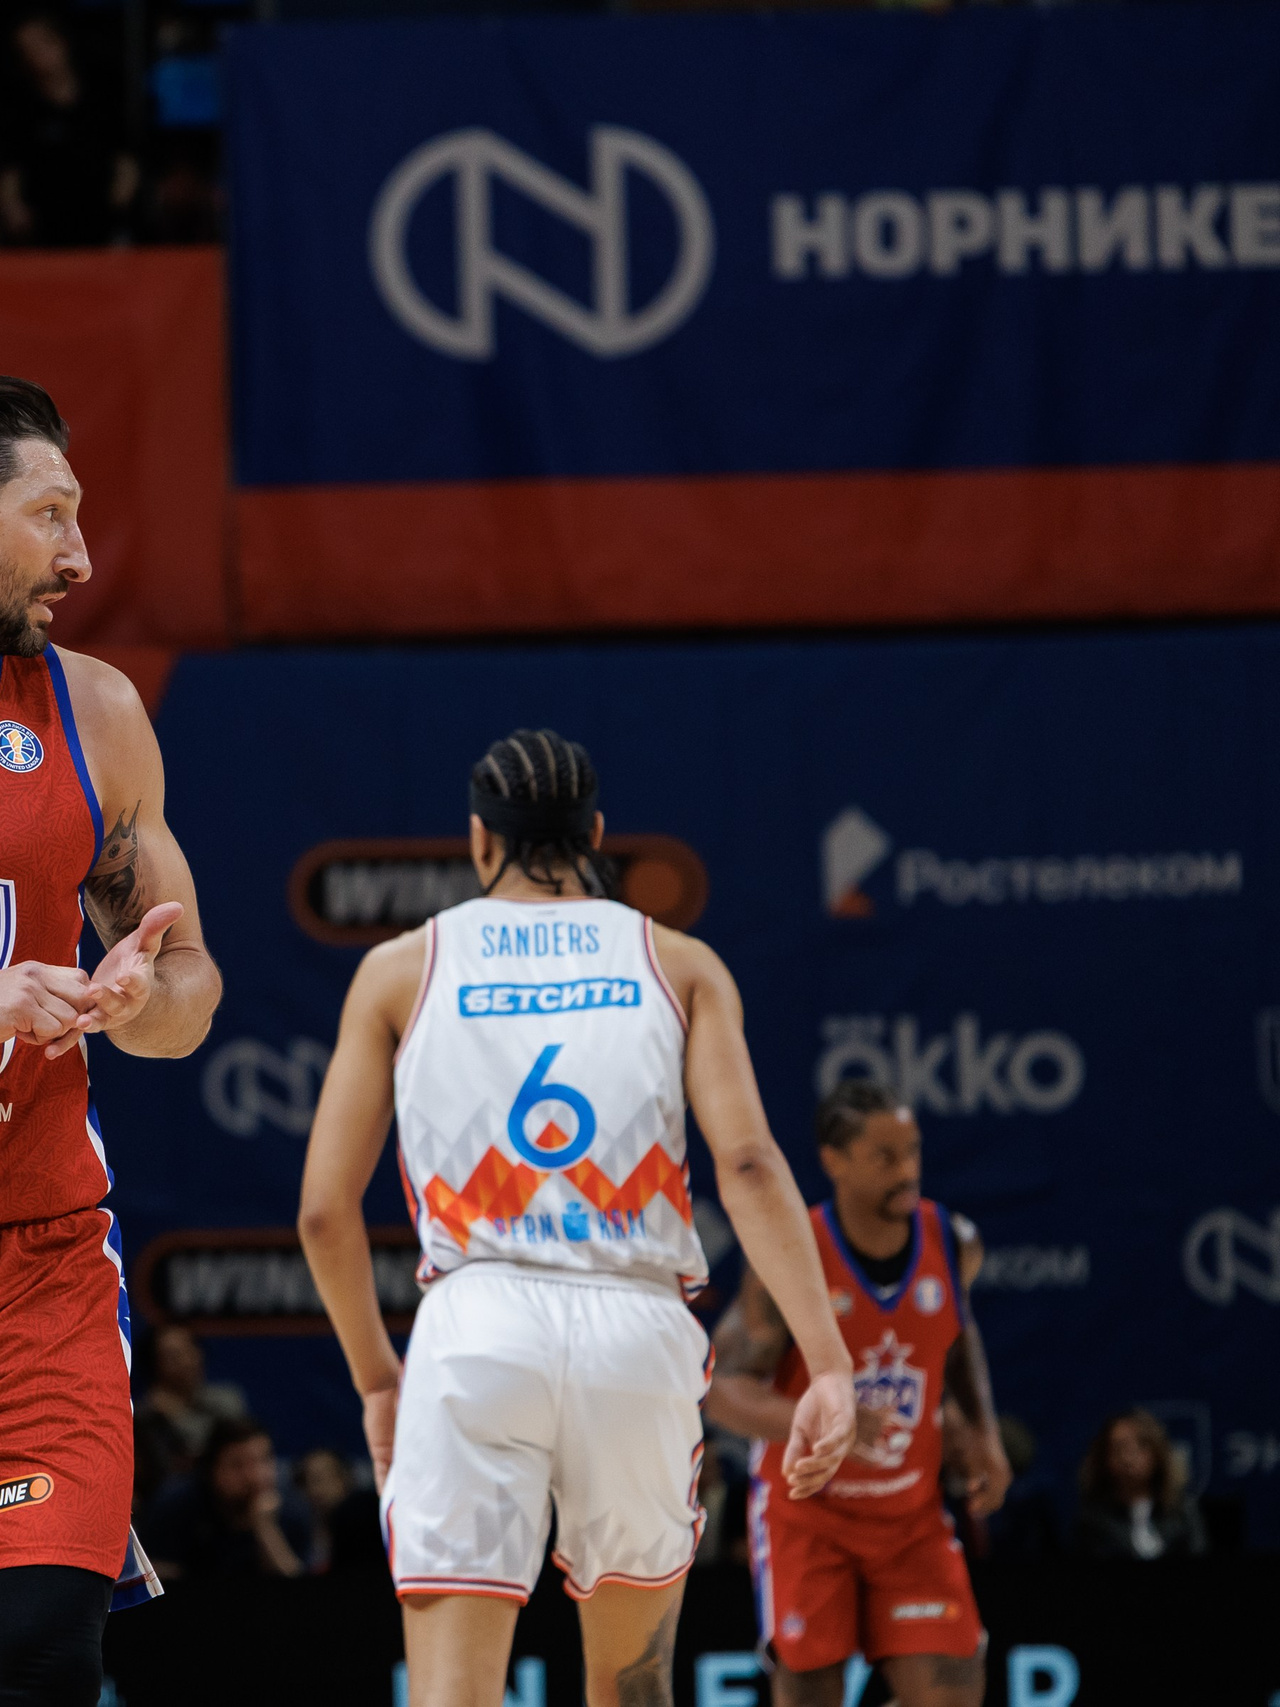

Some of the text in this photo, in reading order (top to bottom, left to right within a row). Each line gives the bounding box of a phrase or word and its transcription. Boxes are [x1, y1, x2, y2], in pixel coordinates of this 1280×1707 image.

[770, 183, 1280, 280] НОРНИКЕ
[481, 921, 601, 958] SANDERS
[464, 982, 635, 1013] БЕТСИТИ
[507, 1042, 597, 1169] 6
